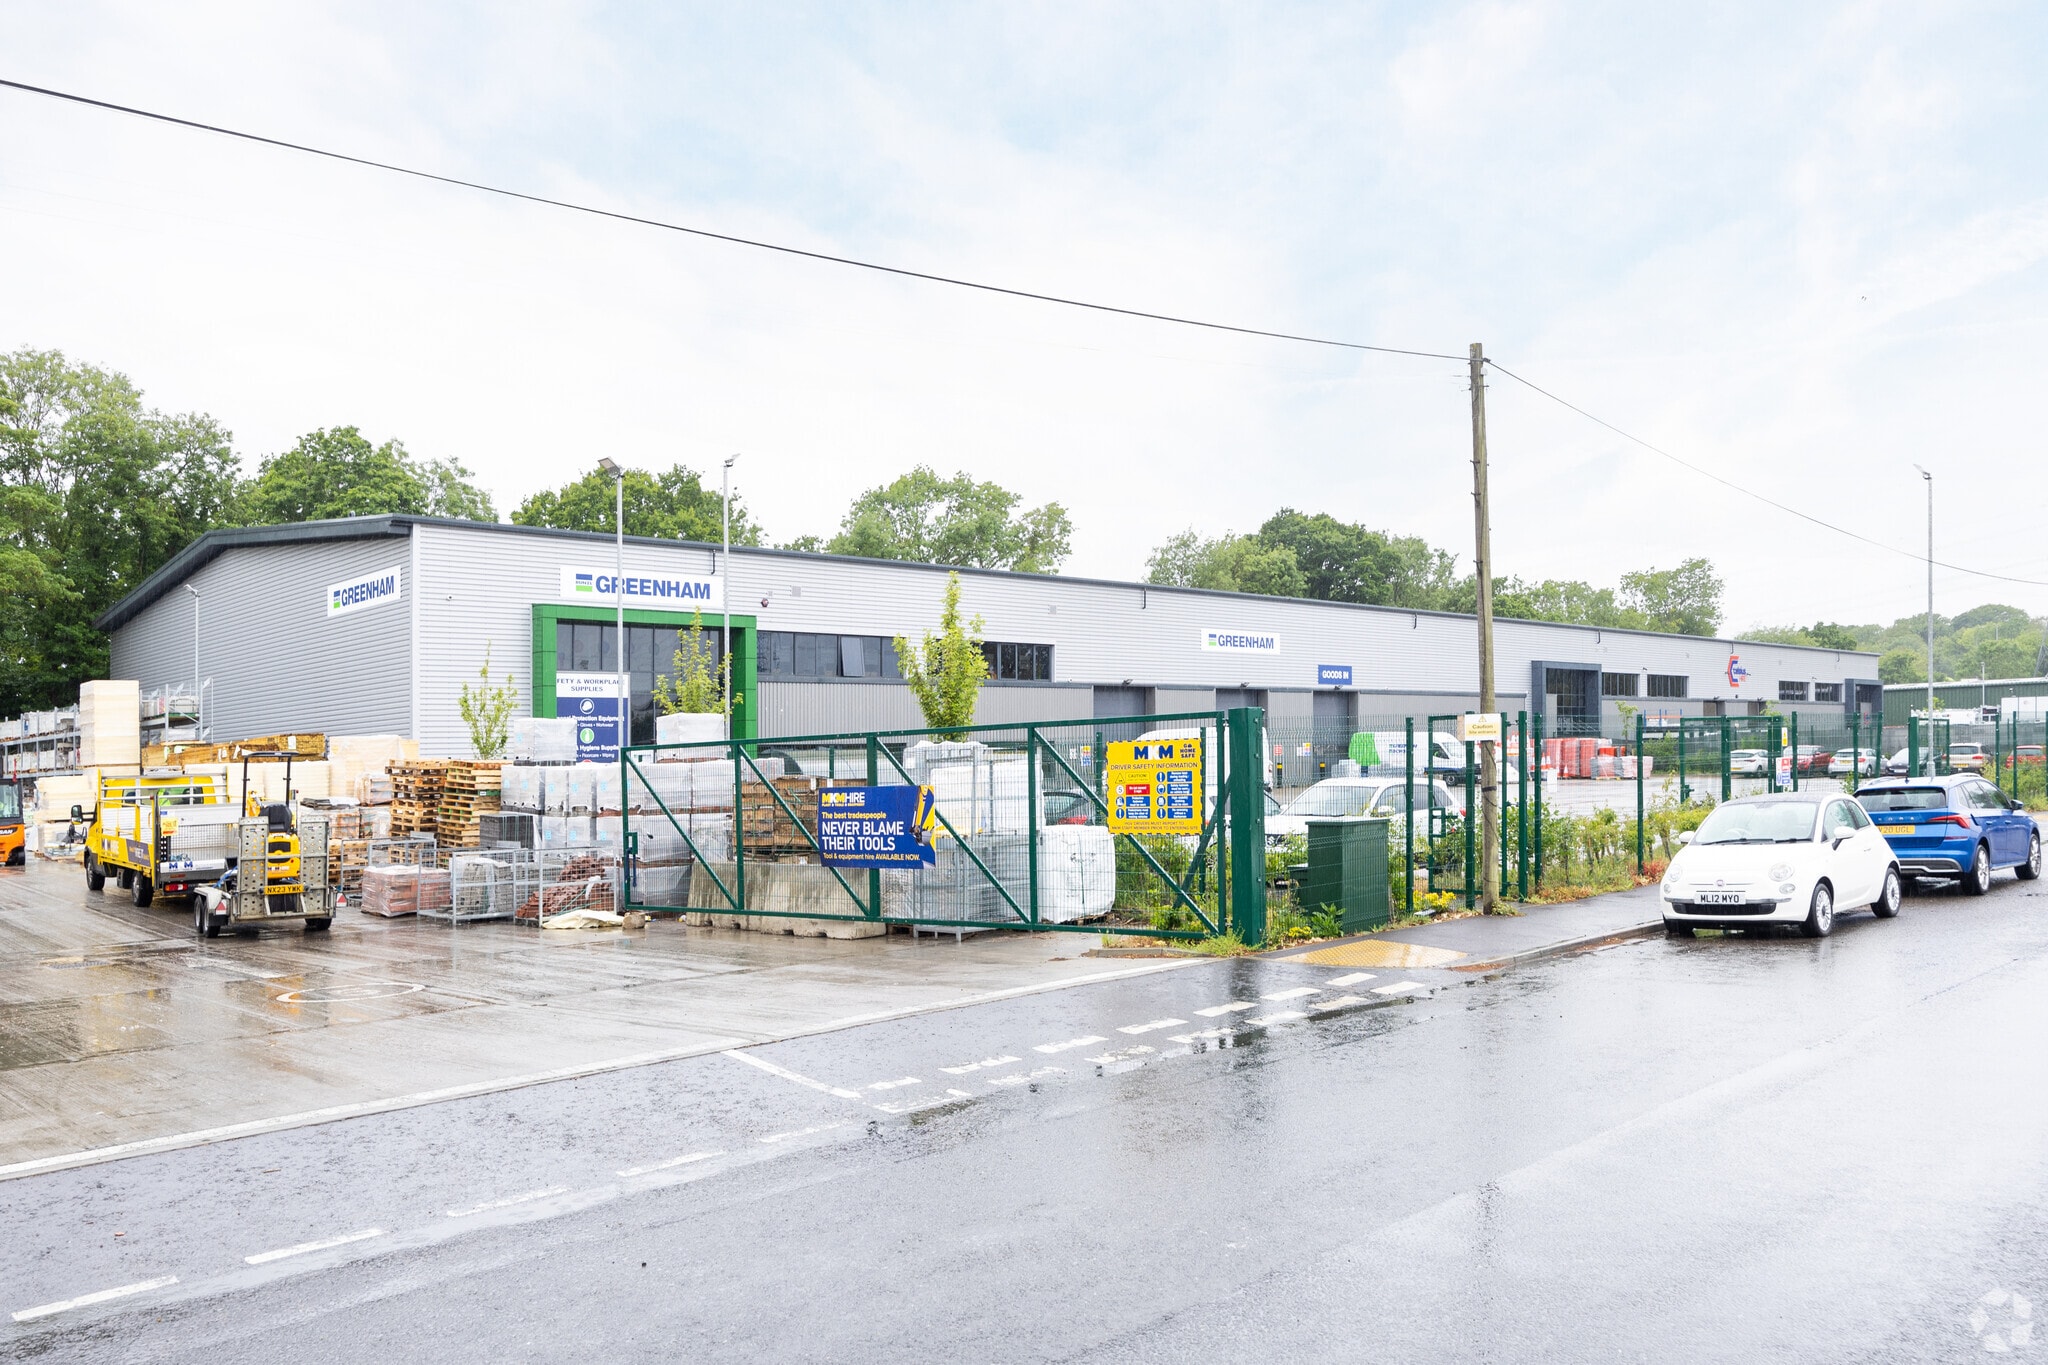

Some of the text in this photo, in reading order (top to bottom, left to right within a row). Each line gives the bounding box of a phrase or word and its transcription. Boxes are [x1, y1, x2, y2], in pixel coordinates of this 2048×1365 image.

[341, 575, 394, 607] GREENHAM
[595, 575, 711, 599] GREENHAM
[1218, 634, 1274, 649] GREENHAM
[1322, 670, 1349, 679] GOODS IN
[1134, 745, 1173, 760] MKM
[845, 792, 865, 803] HIRE
[848, 812, 887, 820] tradespeople
[822, 821, 904, 835] NEVER BLAME
[822, 837, 895, 851] THEIR TOOLS
[1700, 894, 1720, 903] ML12
